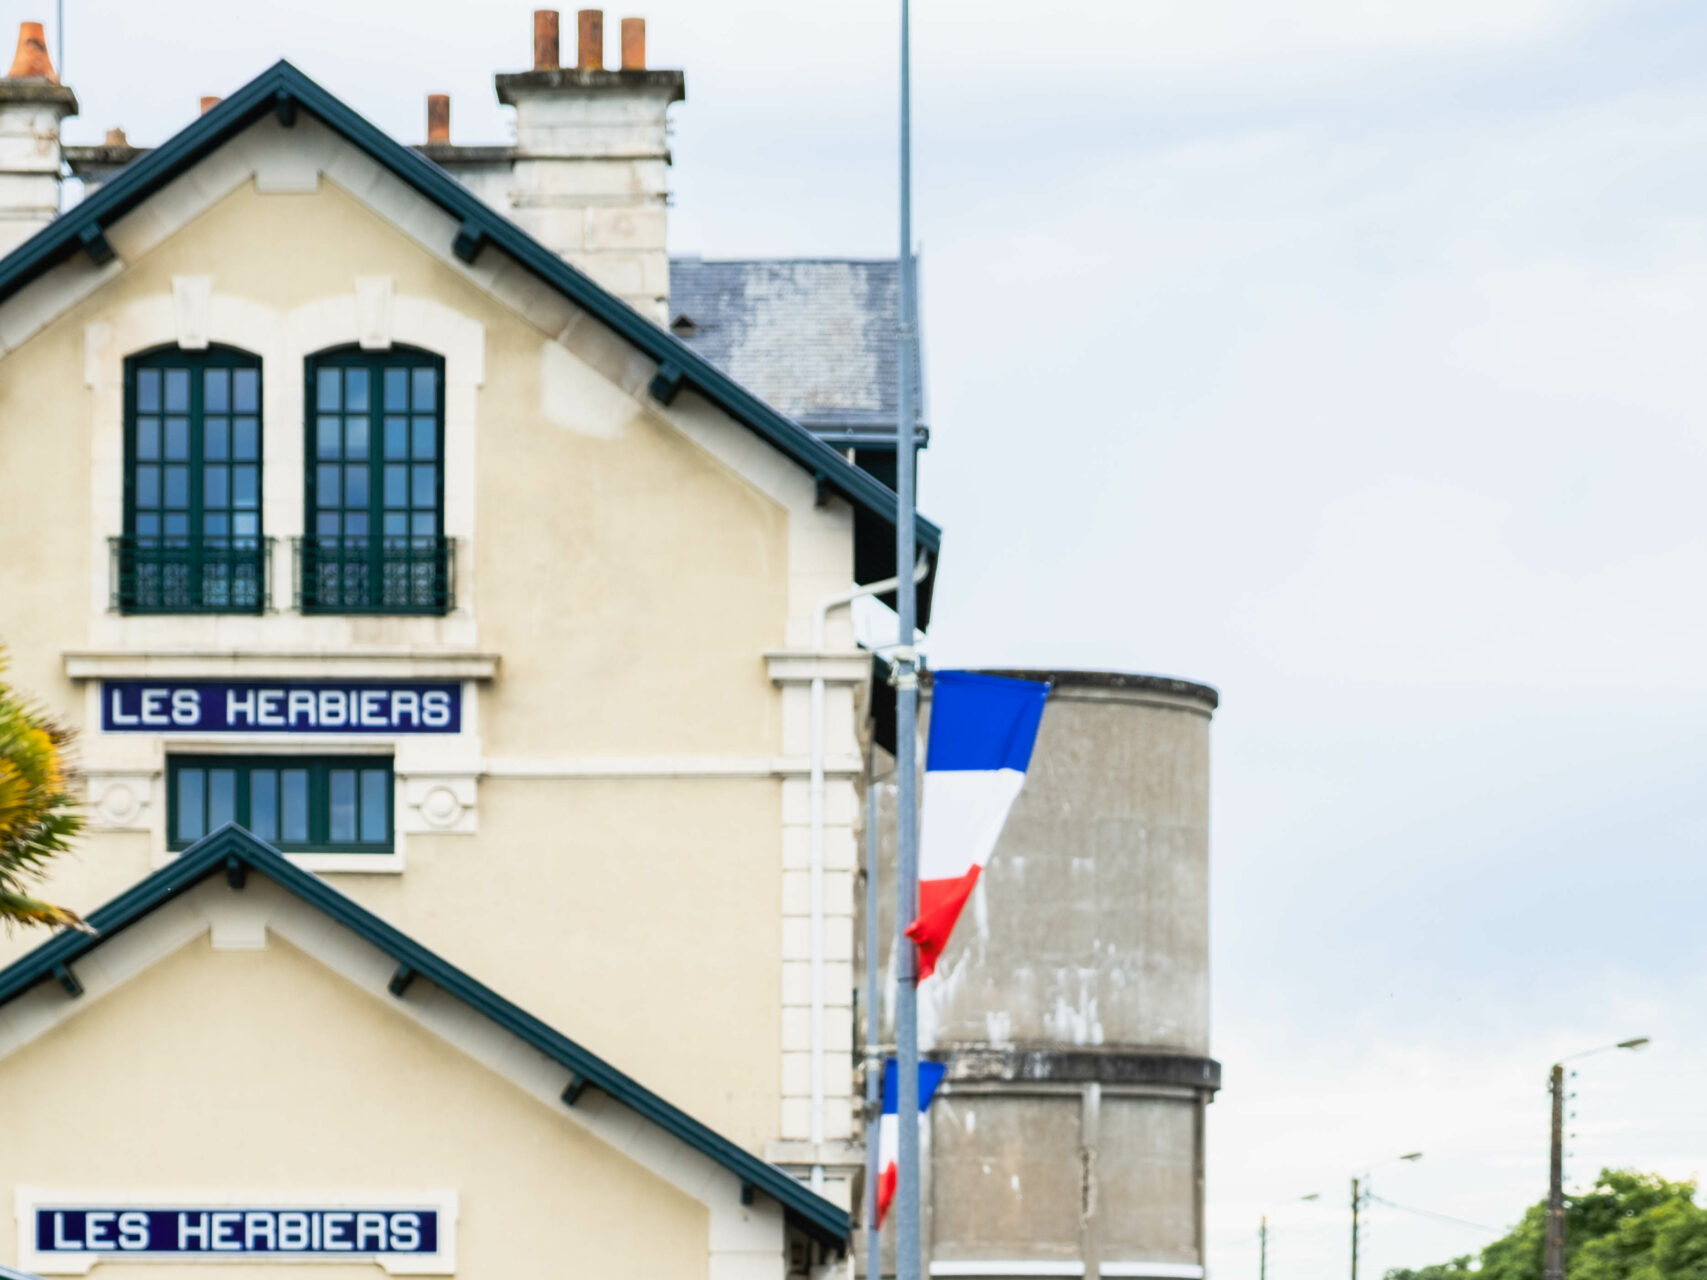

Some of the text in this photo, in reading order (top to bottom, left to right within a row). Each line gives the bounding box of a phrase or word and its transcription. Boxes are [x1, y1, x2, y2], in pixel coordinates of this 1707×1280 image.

[111, 688, 452, 727] LES HERBIERS
[53, 1211, 421, 1252] LES HERBIERS
